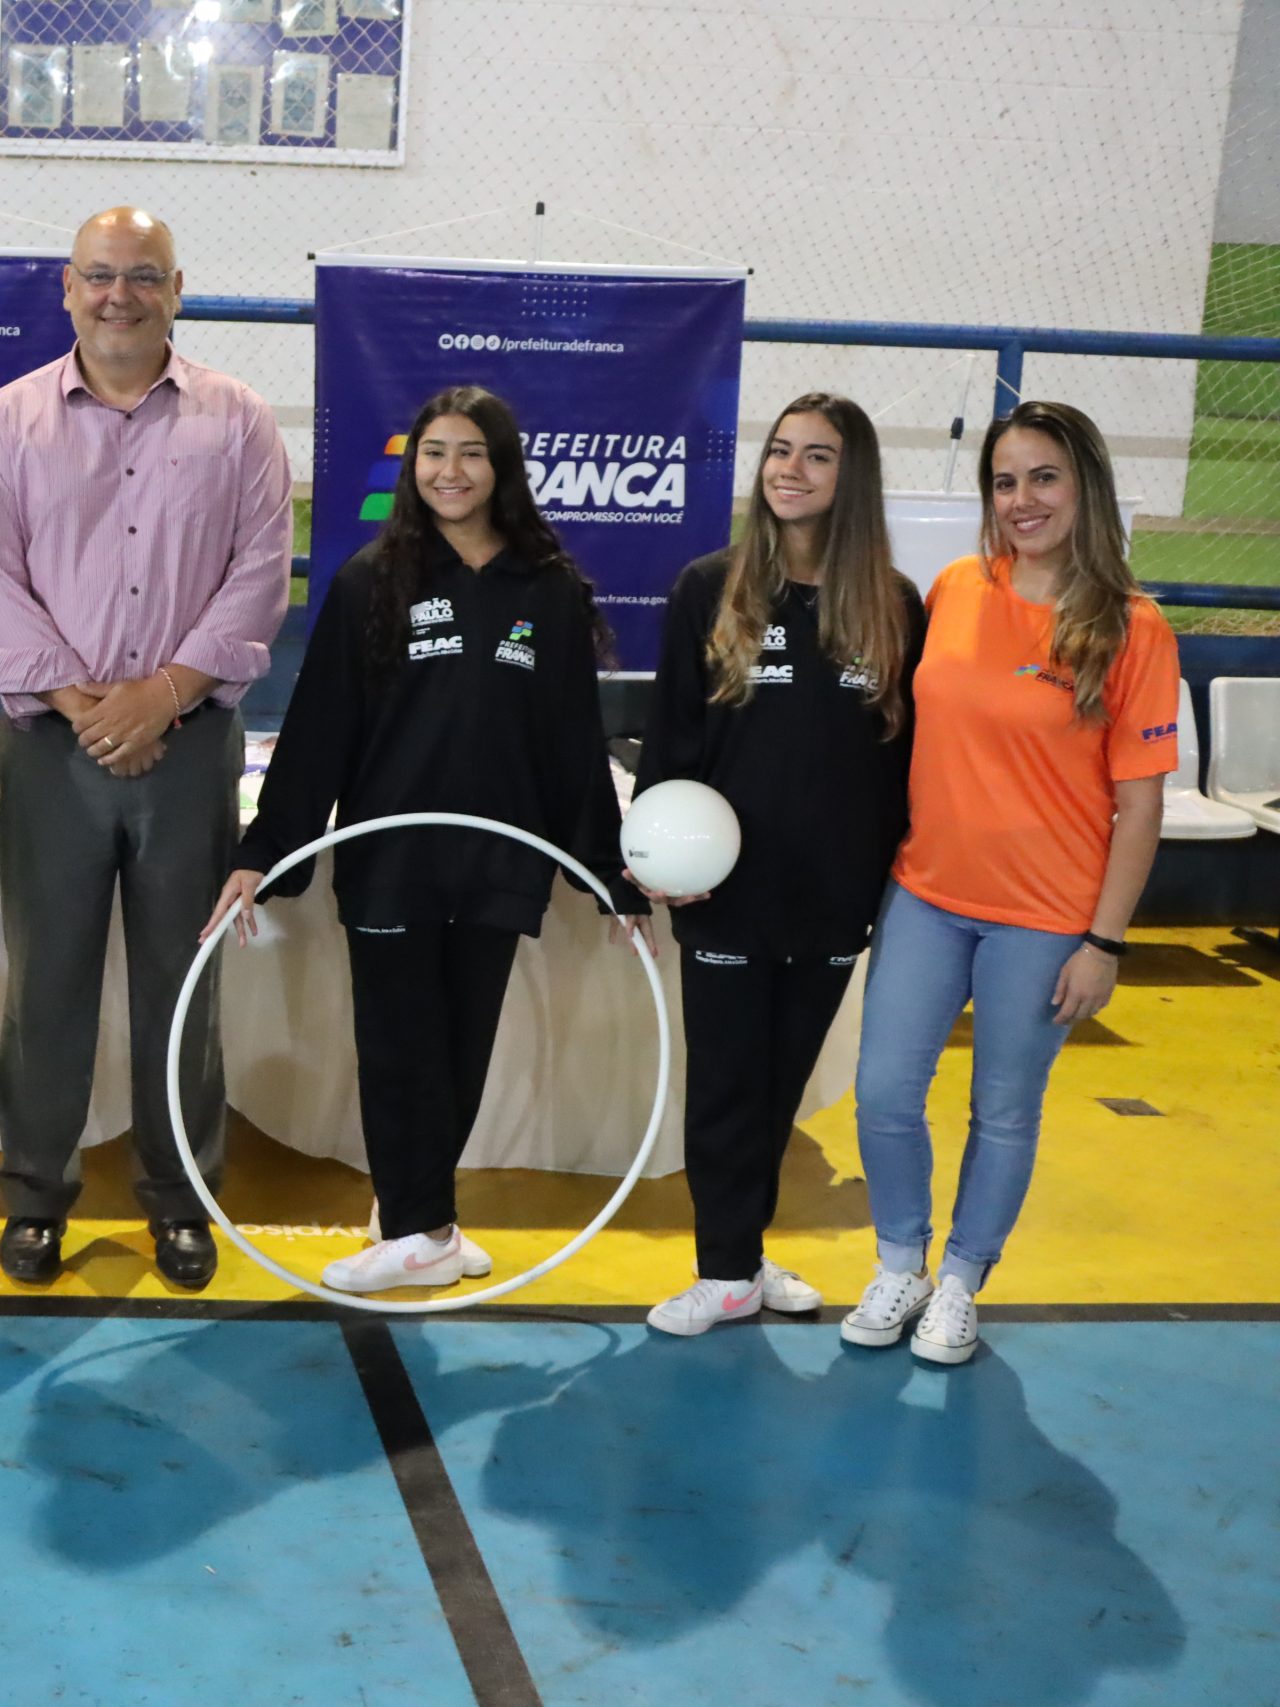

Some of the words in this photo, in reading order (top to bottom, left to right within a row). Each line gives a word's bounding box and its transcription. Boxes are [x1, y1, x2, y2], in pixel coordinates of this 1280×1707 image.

[501, 337, 625, 353] /prefeituradefranca
[624, 512, 652, 523] COM
[424, 597, 452, 610] SÃO
[408, 635, 463, 655] FEAC
